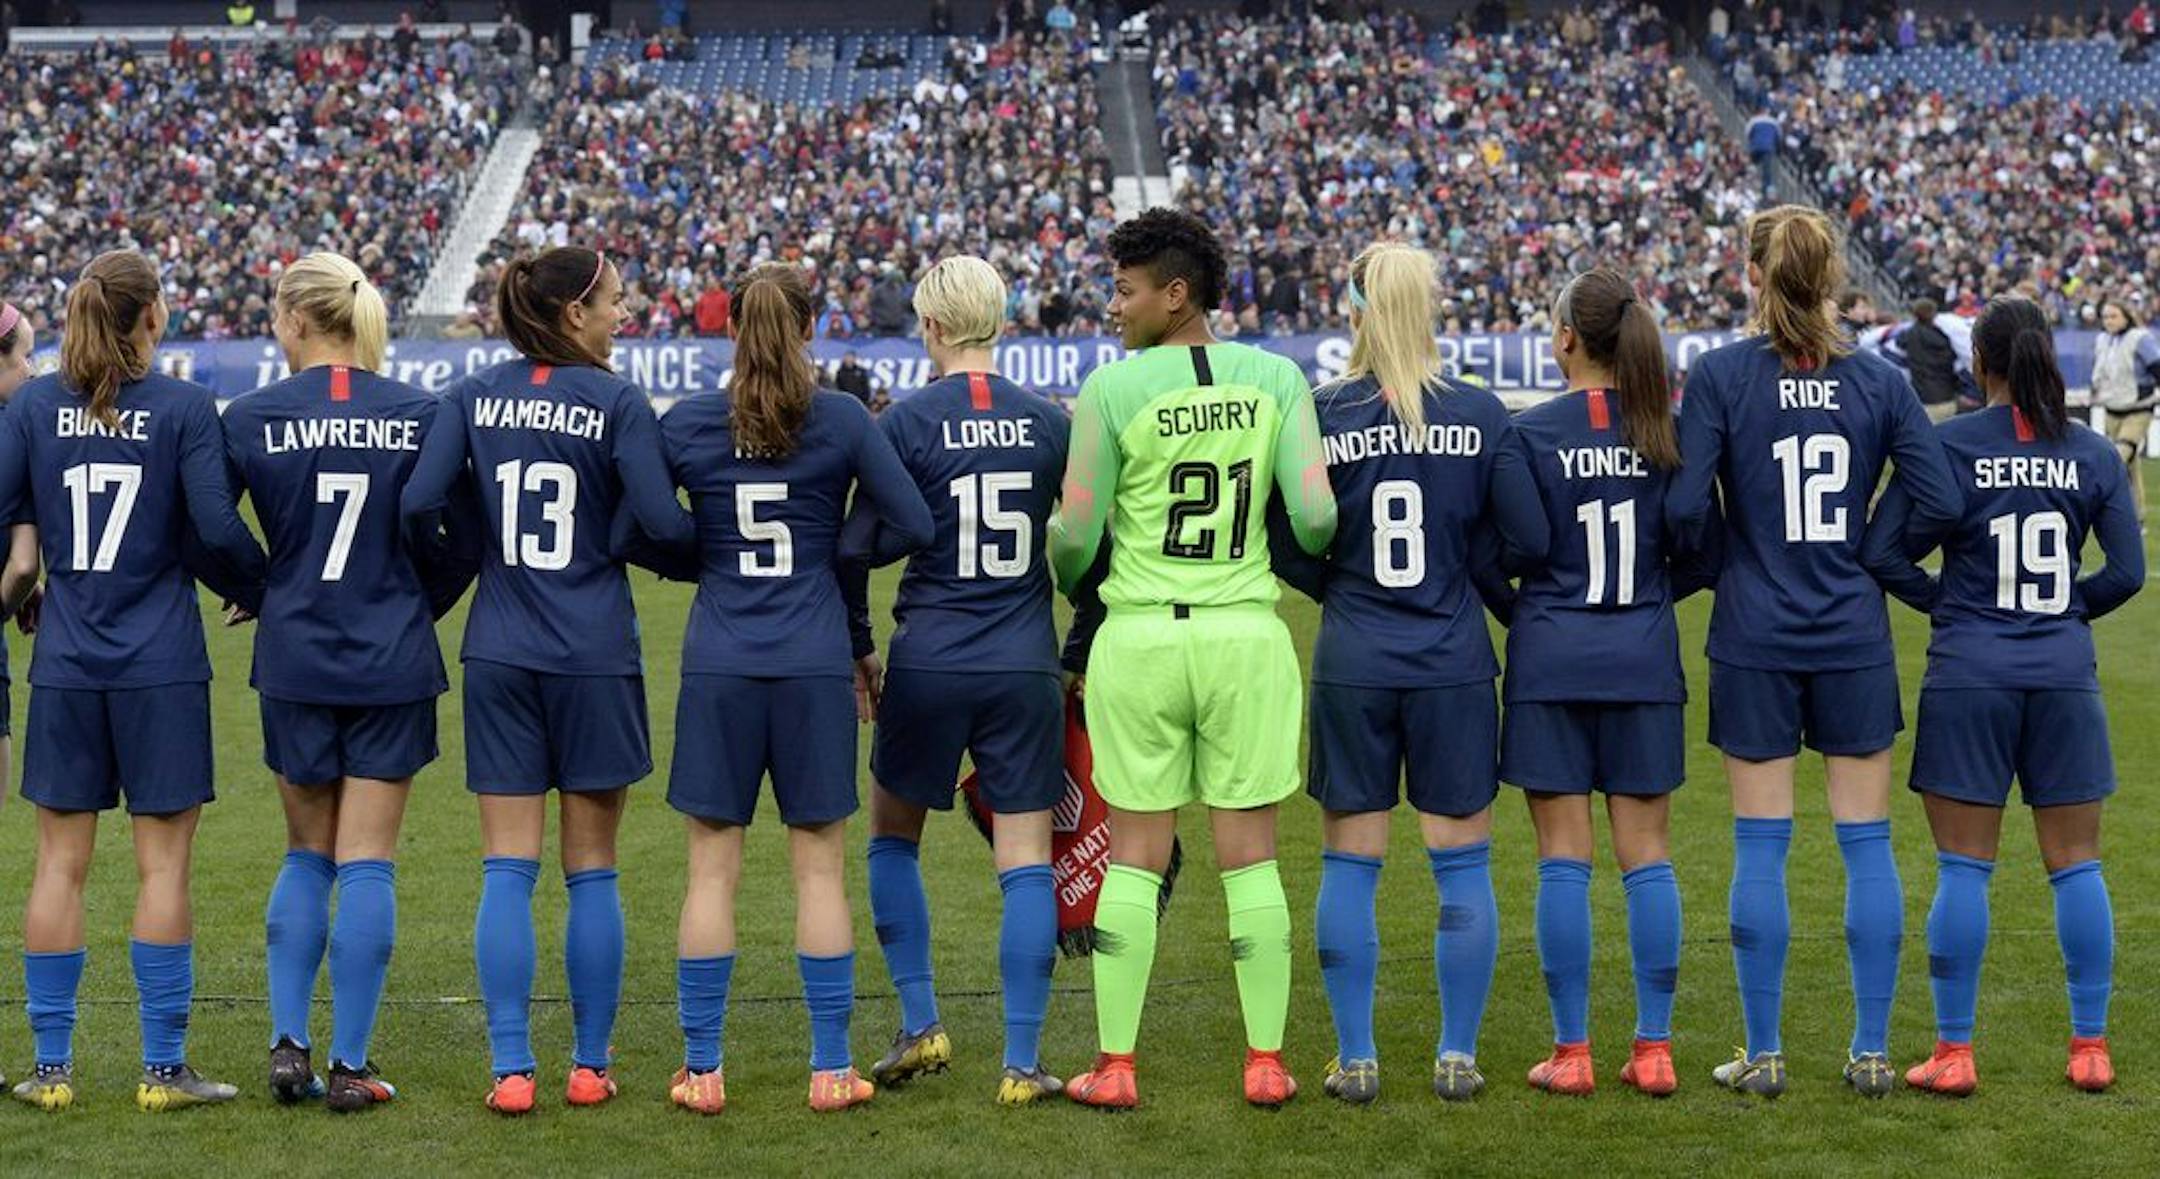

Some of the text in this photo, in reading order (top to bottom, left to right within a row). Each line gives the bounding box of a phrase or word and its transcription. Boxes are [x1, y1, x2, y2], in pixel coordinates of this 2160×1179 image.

[993, 343, 1080, 387] OUR
[1778, 378, 1841, 411] RIDE
[264, 417, 419, 454] LAWRENCE
[474, 397, 605, 441] WAMBACH
[942, 418, 1035, 450] LORDE
[1158, 400, 1258, 437] SCURRY
[63, 462, 143, 572] 17
[495, 458, 577, 571] 13
[1162, 458, 1252, 560] 21
[1772, 433, 1850, 542] 12
[1974, 456, 2080, 491] SERENA
[316, 472, 370, 581] 7
[735, 482, 793, 577] 5
[949, 471, 1033, 578] 15
[1372, 479, 1426, 588] 8
[1576, 498, 1636, 605] 11
[1989, 511, 2071, 615] 19
[1053, 819, 1111, 888] NE NATI
[1060, 869, 1098, 907] ONE
